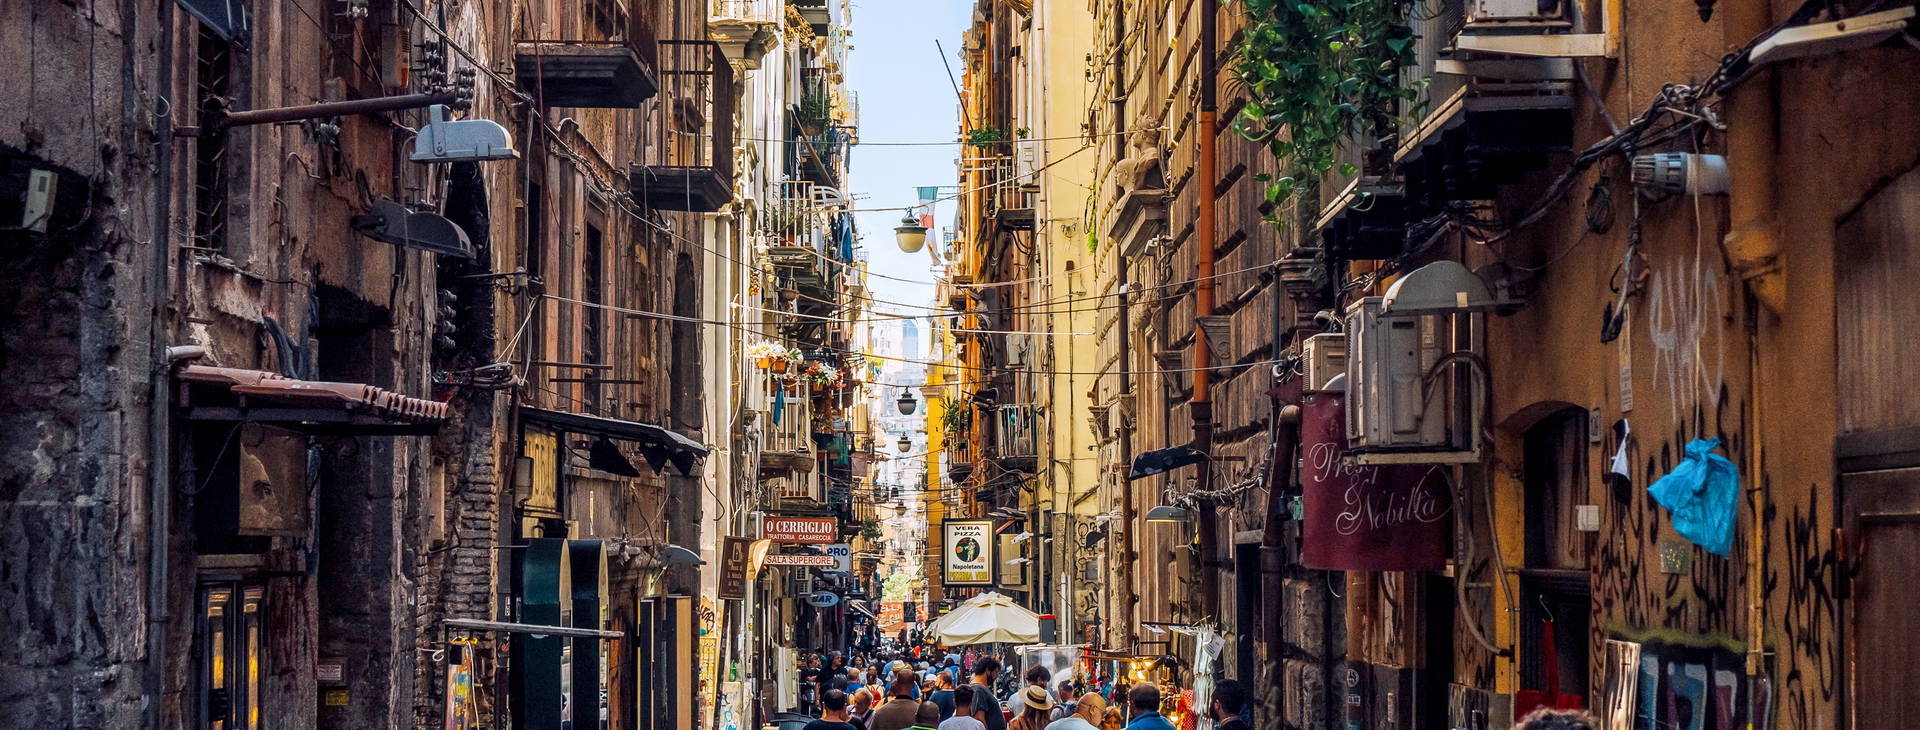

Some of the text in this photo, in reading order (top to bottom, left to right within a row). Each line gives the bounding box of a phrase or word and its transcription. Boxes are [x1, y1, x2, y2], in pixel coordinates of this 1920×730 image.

[776, 520, 832, 534] CERRIGLIO
[766, 556, 789, 564] SALA
[791, 556, 831, 565] SUPERIORE
[952, 563, 984, 571] Napoletana
